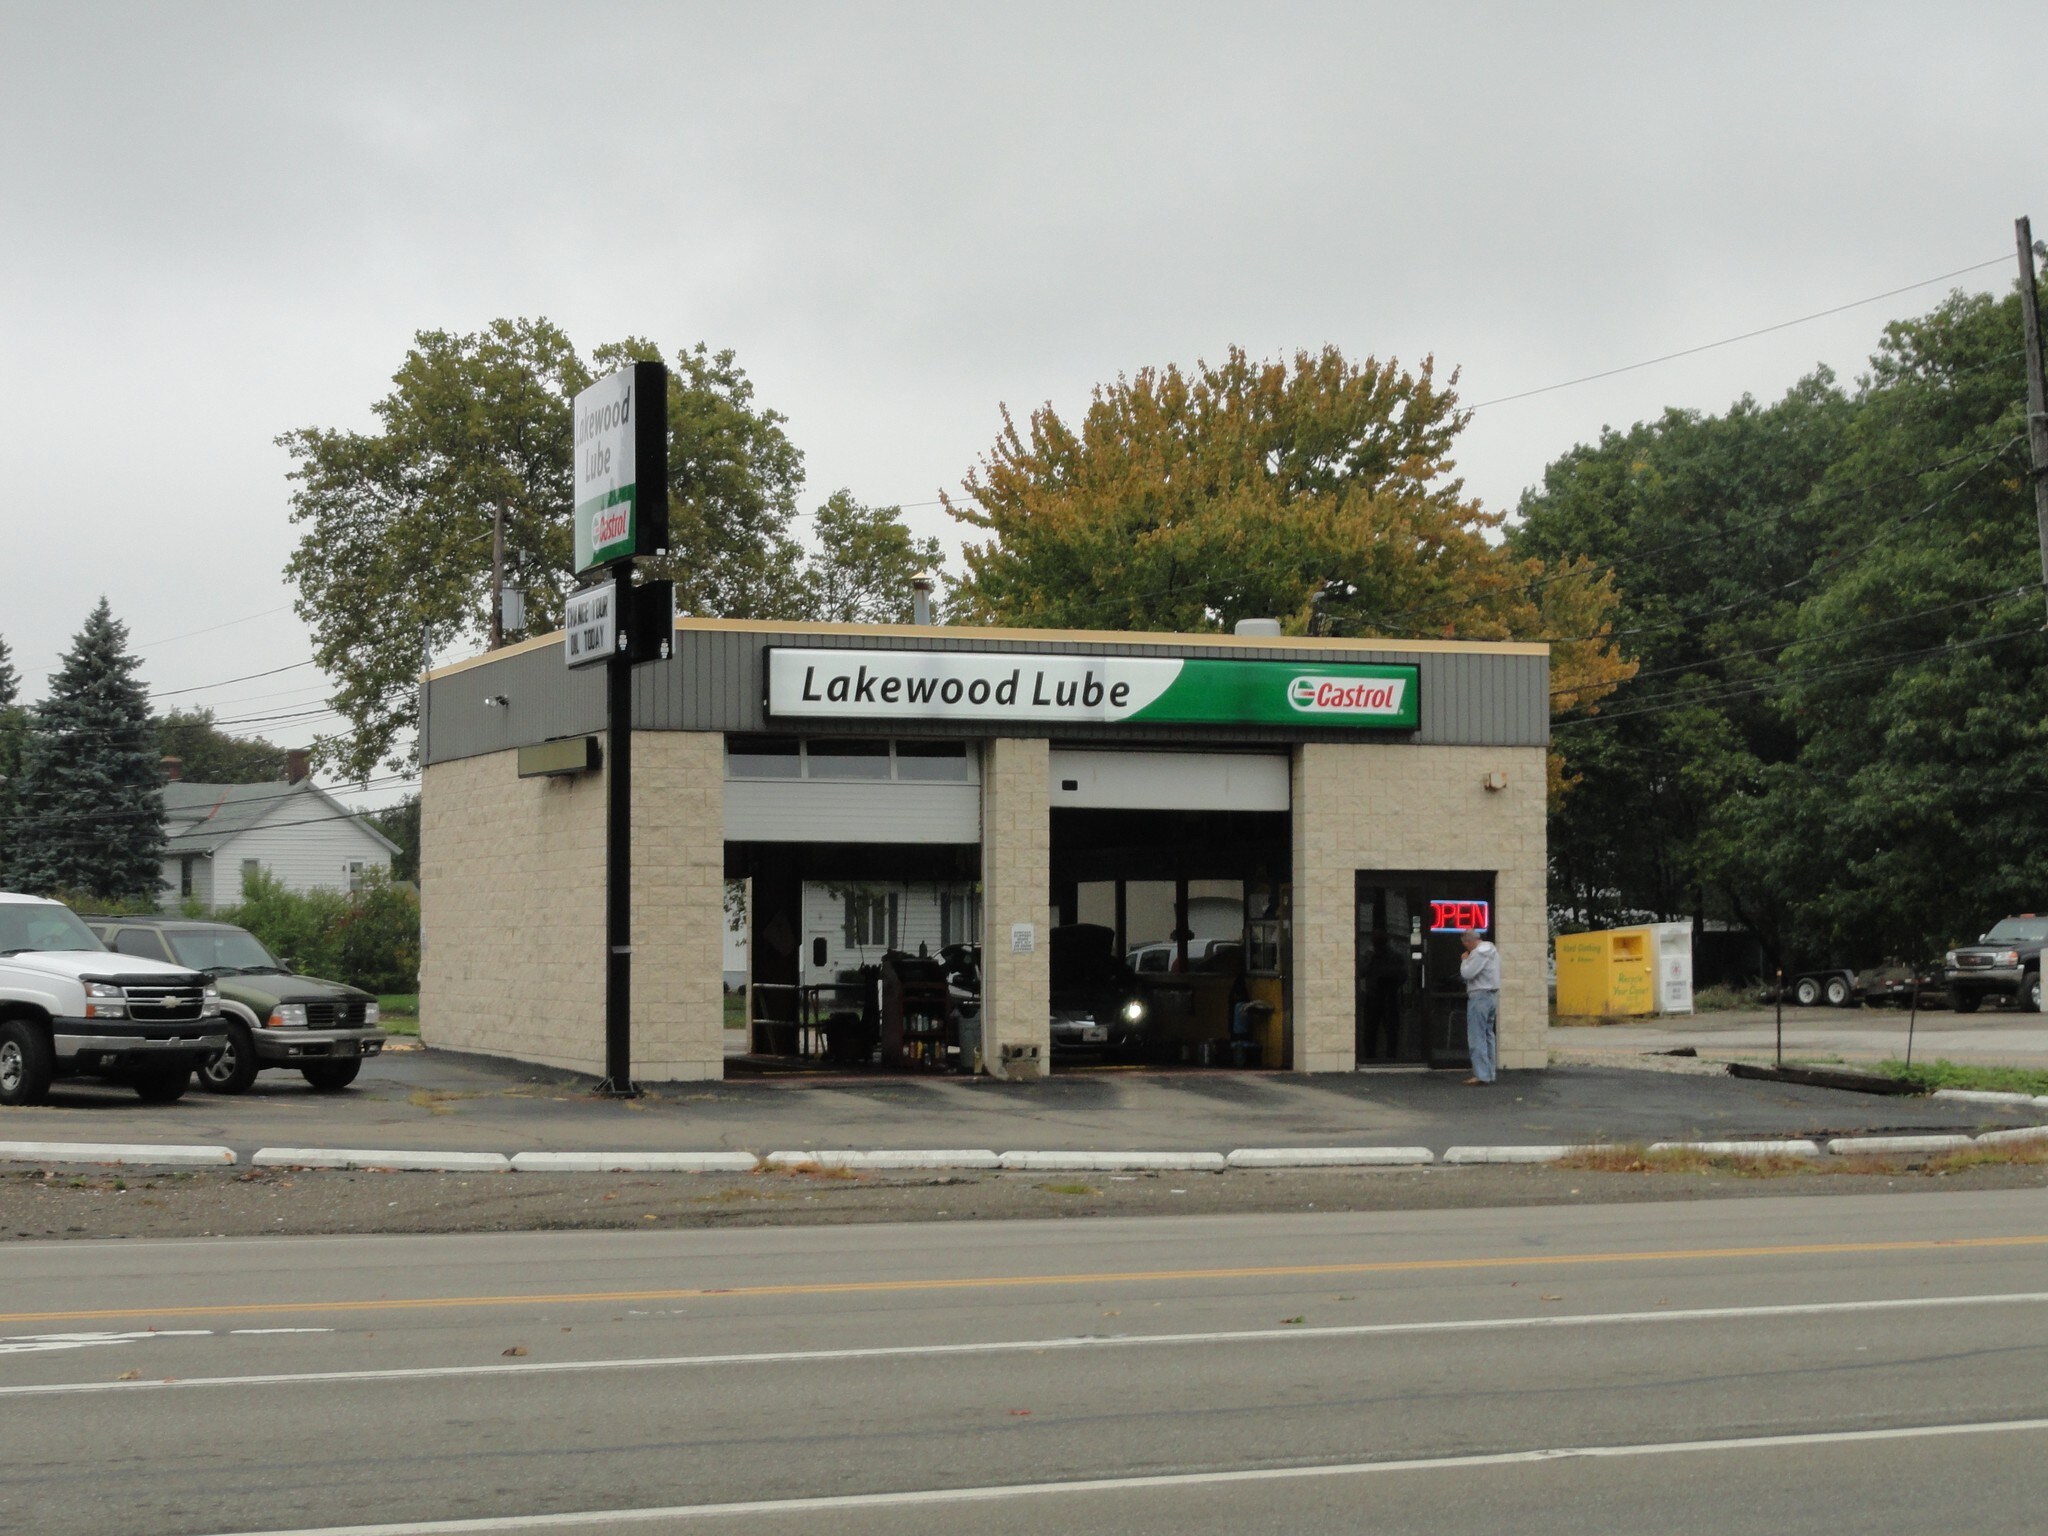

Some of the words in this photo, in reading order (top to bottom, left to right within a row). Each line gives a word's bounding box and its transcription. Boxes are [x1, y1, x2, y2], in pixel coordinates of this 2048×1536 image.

[585, 440, 611, 483] Lube
[599, 510, 627, 542] Castrol
[570, 632, 580, 656] OIL
[584, 624, 605, 652] TODAY
[802, 666, 1020, 704] Lakewood
[1032, 671, 1130, 708] Lube
[1316, 681, 1395, 711] Castrol
